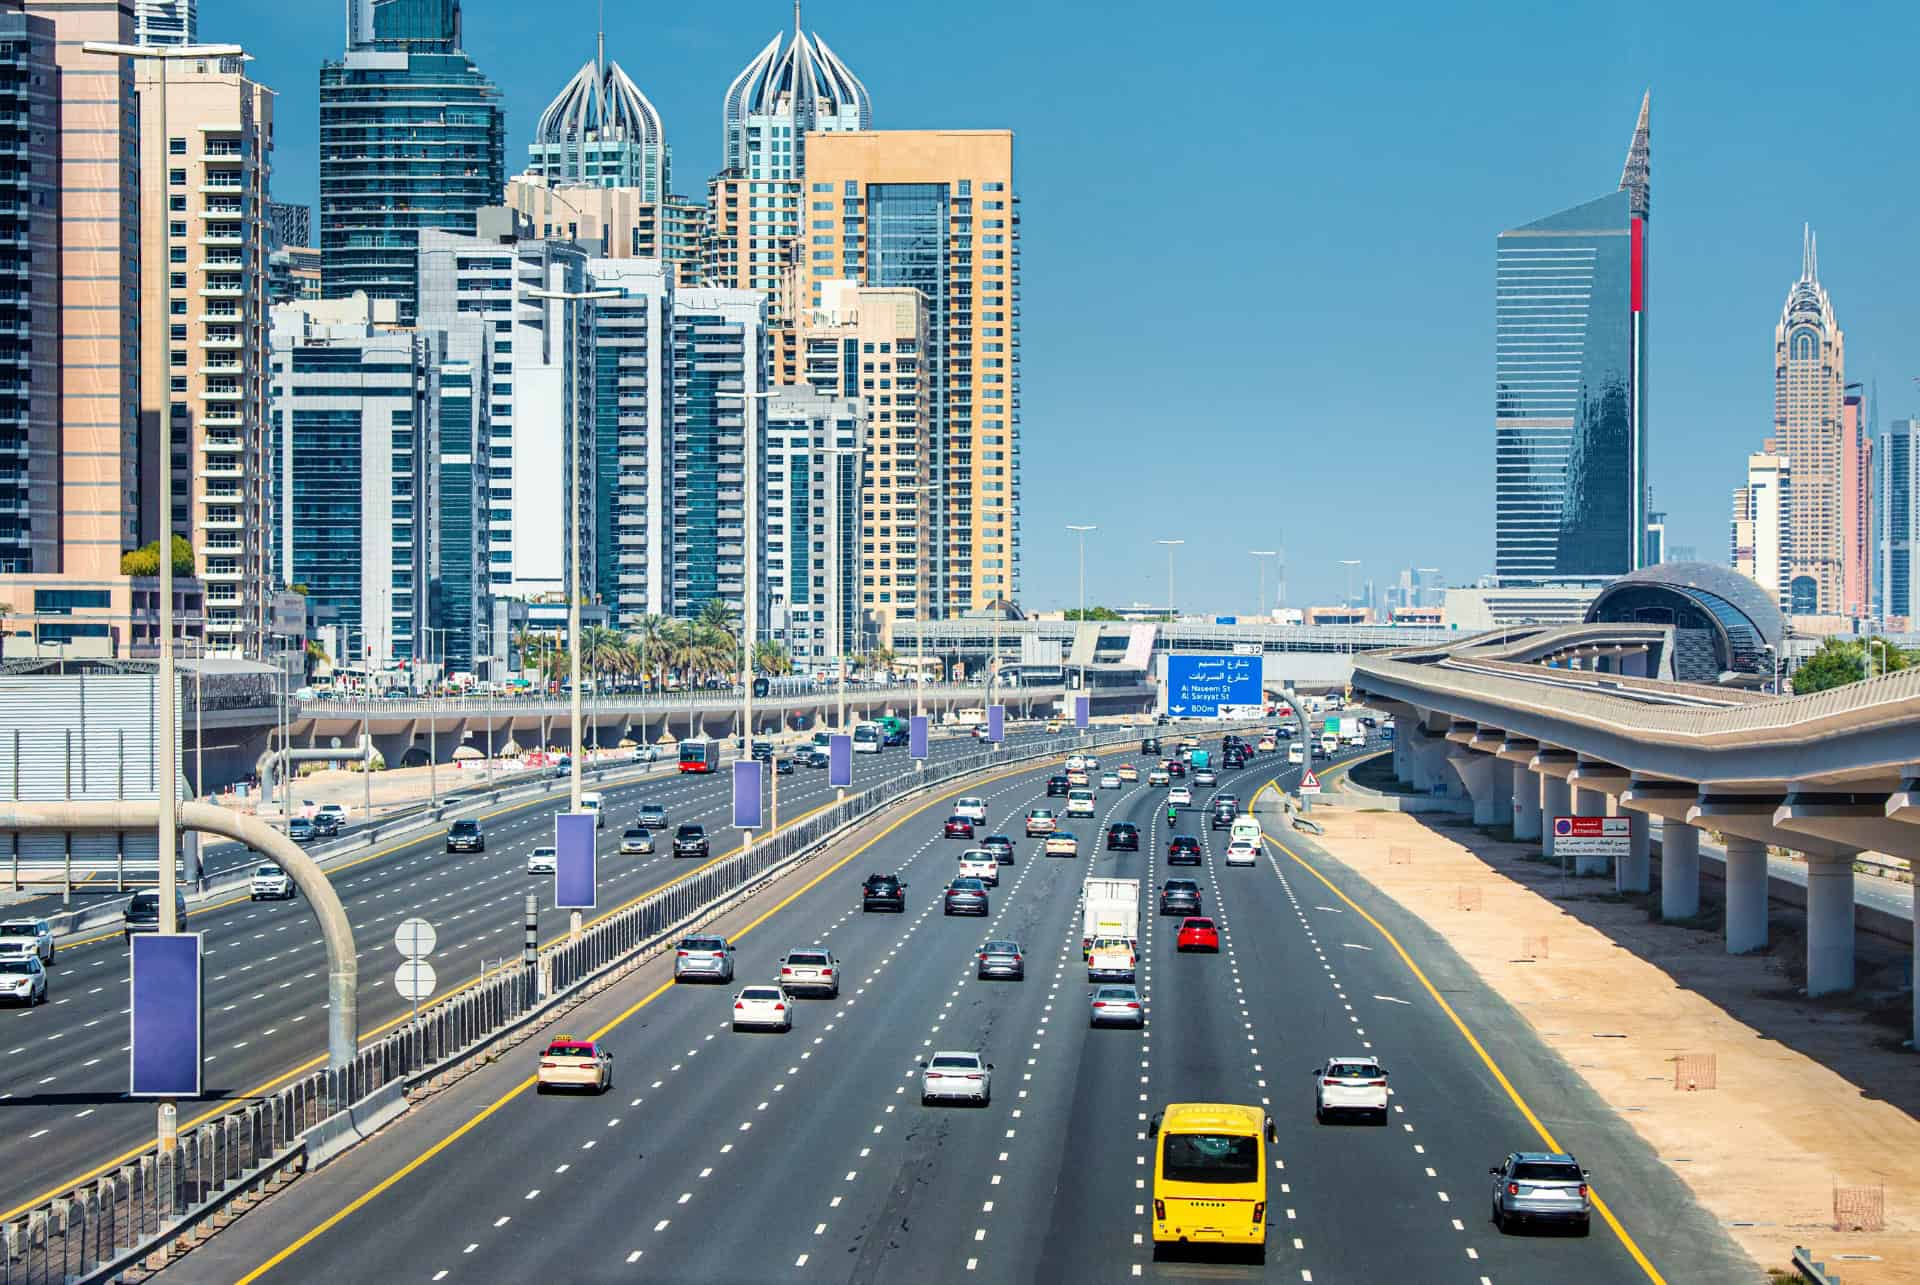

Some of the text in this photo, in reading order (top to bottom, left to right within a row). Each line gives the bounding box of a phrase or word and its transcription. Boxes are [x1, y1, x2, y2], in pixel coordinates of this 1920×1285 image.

[1227, 659, 1249, 670] شارع
[1227, 672, 1249, 683] شارع
[1191, 684, 1220, 692] Naseem
